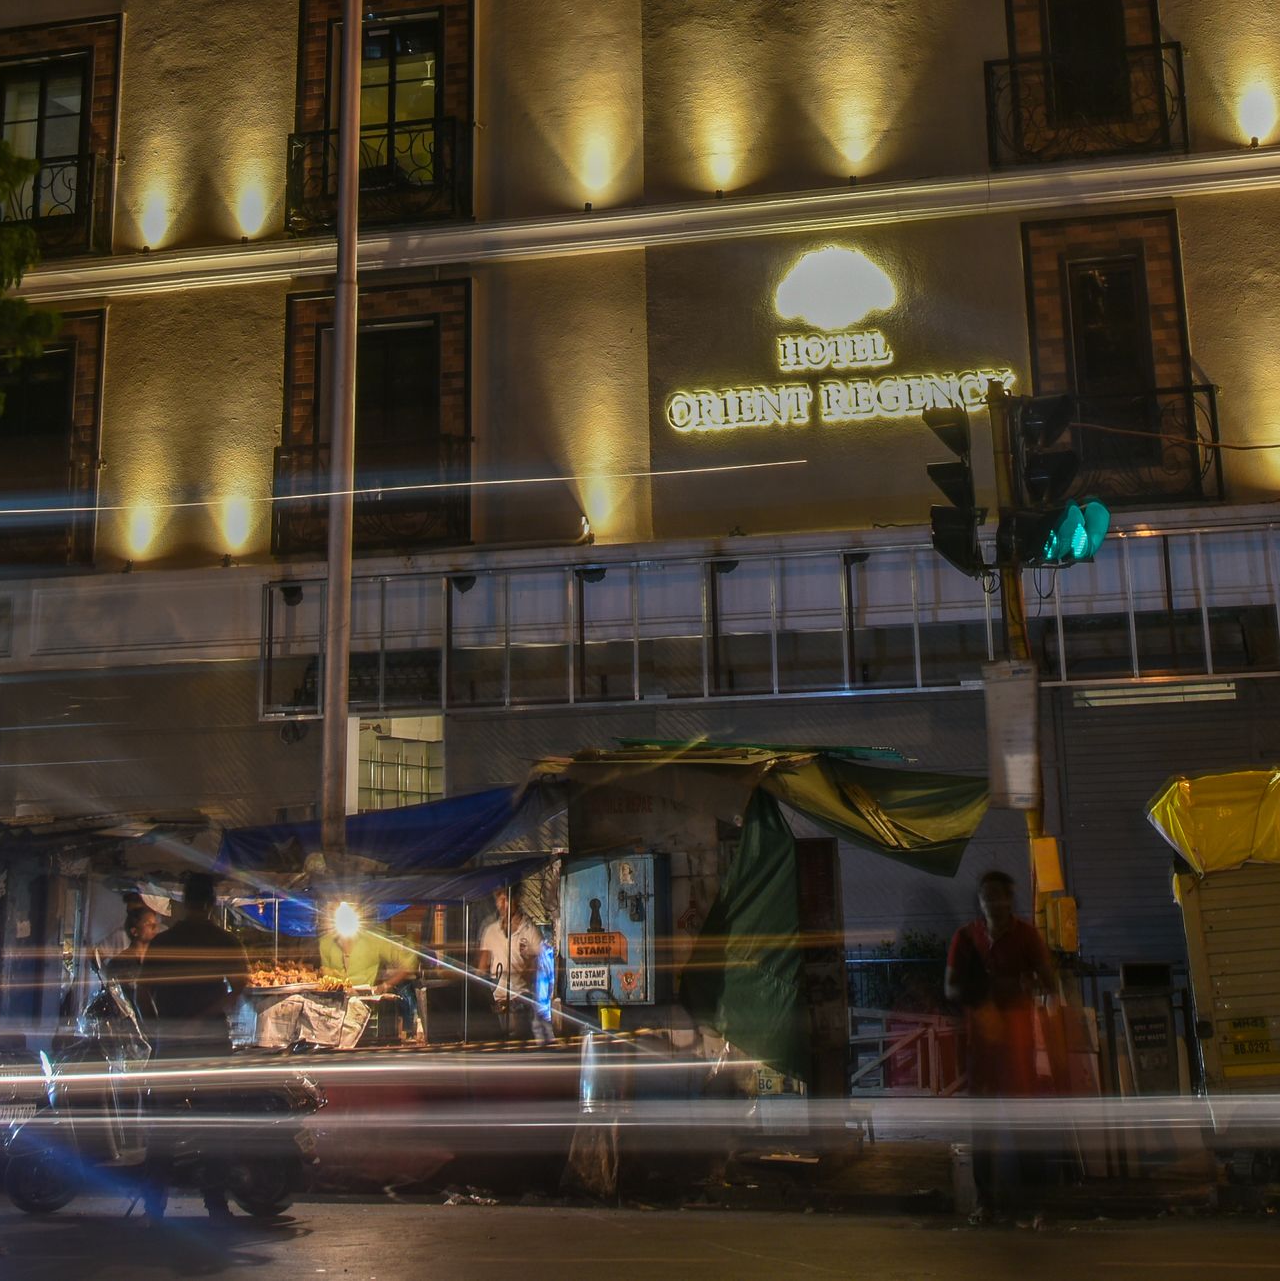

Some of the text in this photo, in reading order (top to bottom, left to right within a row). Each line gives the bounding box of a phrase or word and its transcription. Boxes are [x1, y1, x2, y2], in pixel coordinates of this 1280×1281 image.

[778, 330, 892, 370] HOTEL
[668, 383, 812, 431] ORIENT
[572, 935, 616, 945] RUBBER
[576, 946, 612, 955] STAMP
[571, 970, 606, 979] GST STAMP
